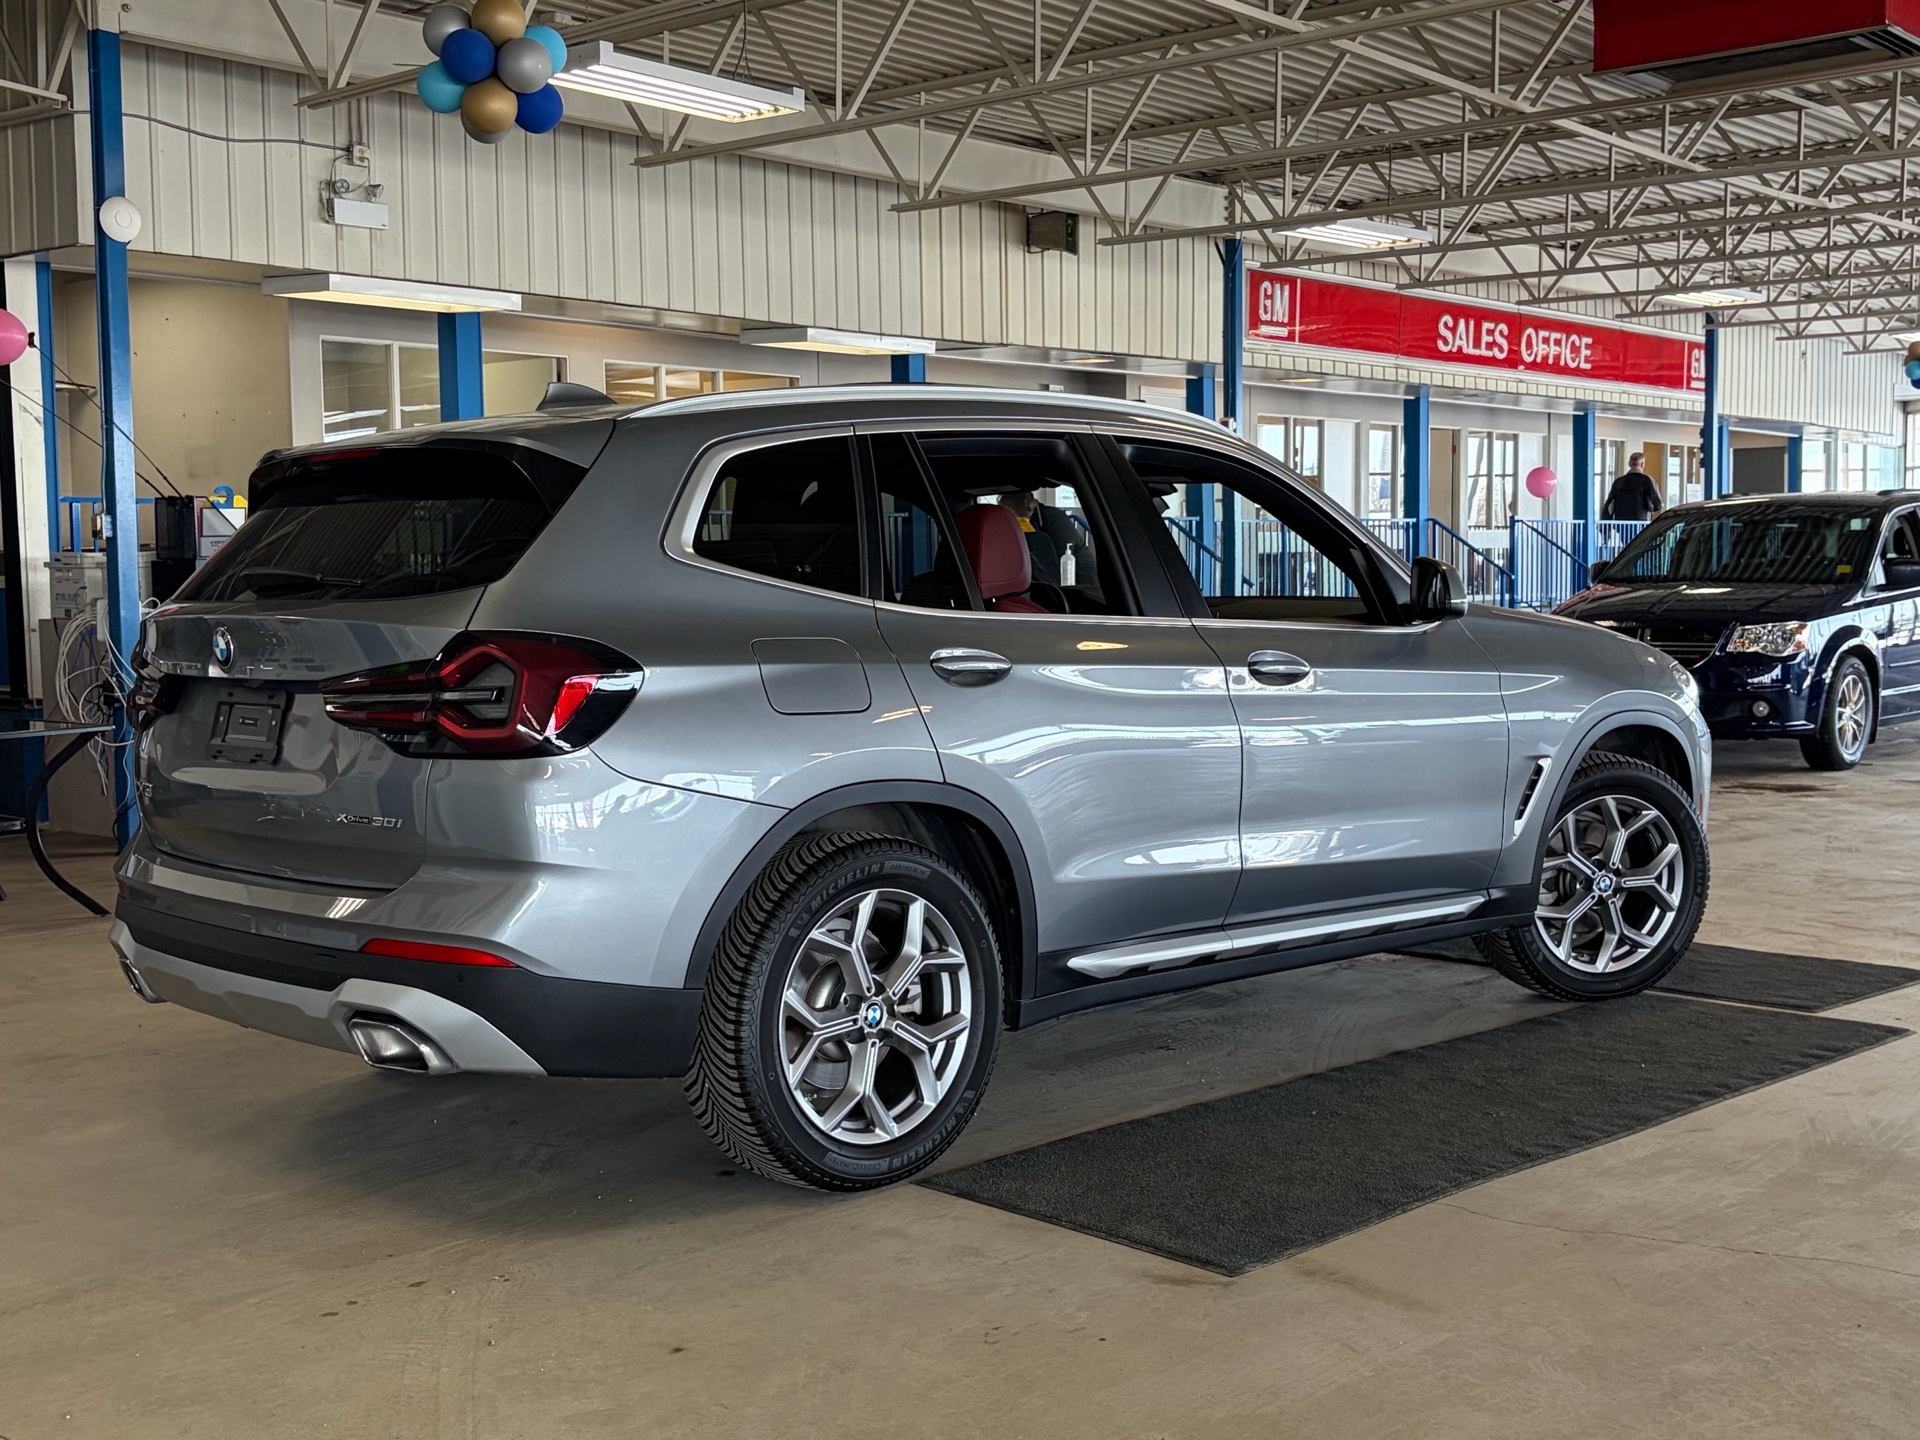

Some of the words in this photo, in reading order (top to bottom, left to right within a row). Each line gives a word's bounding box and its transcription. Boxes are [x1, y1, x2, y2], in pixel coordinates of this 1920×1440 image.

[1259, 280, 1289, 323] GM
[1437, 314, 1509, 360] SALES
[1521, 327, 1593, 370] OFFICE
[811, 862, 881, 911] MICHELIN
[891, 1116, 957, 1168] MICHELIN
